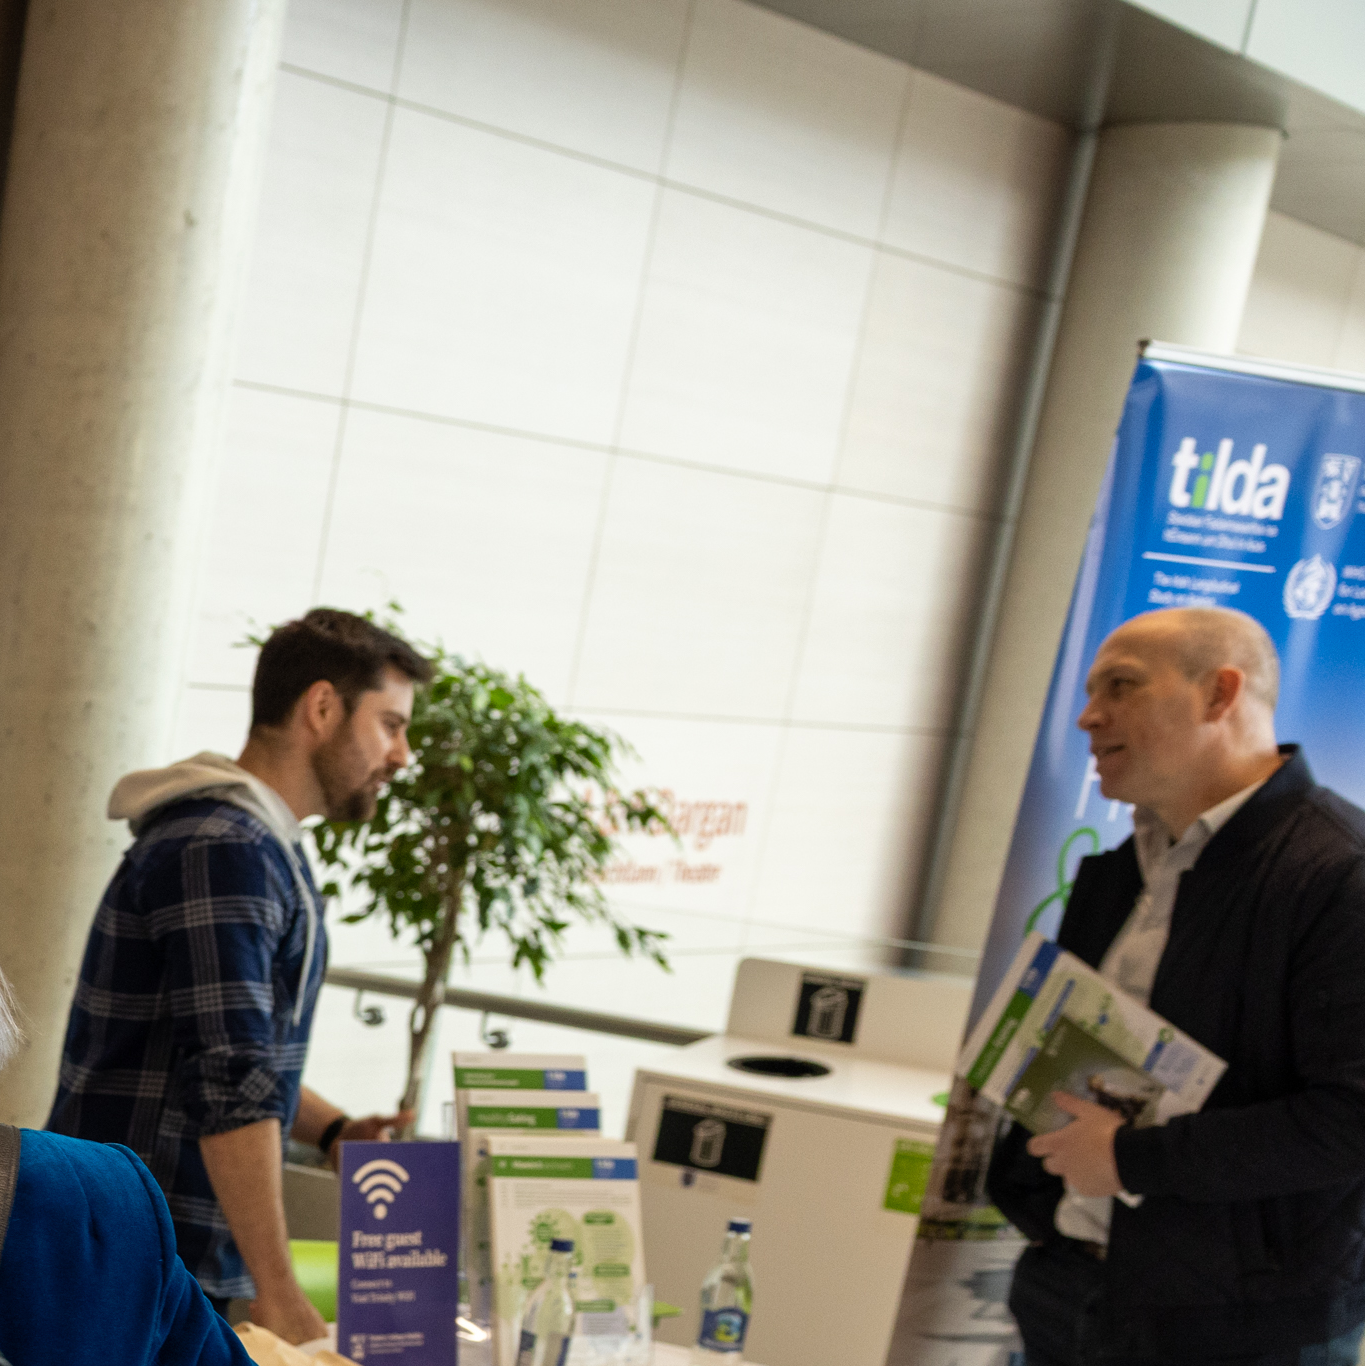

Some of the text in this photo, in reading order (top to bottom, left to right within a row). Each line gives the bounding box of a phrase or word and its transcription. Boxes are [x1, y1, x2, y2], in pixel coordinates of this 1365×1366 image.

[1168, 437, 1291, 520] tilda
[352, 1230, 423, 1251] Free guest
[387, 1248, 448, 1269] available
